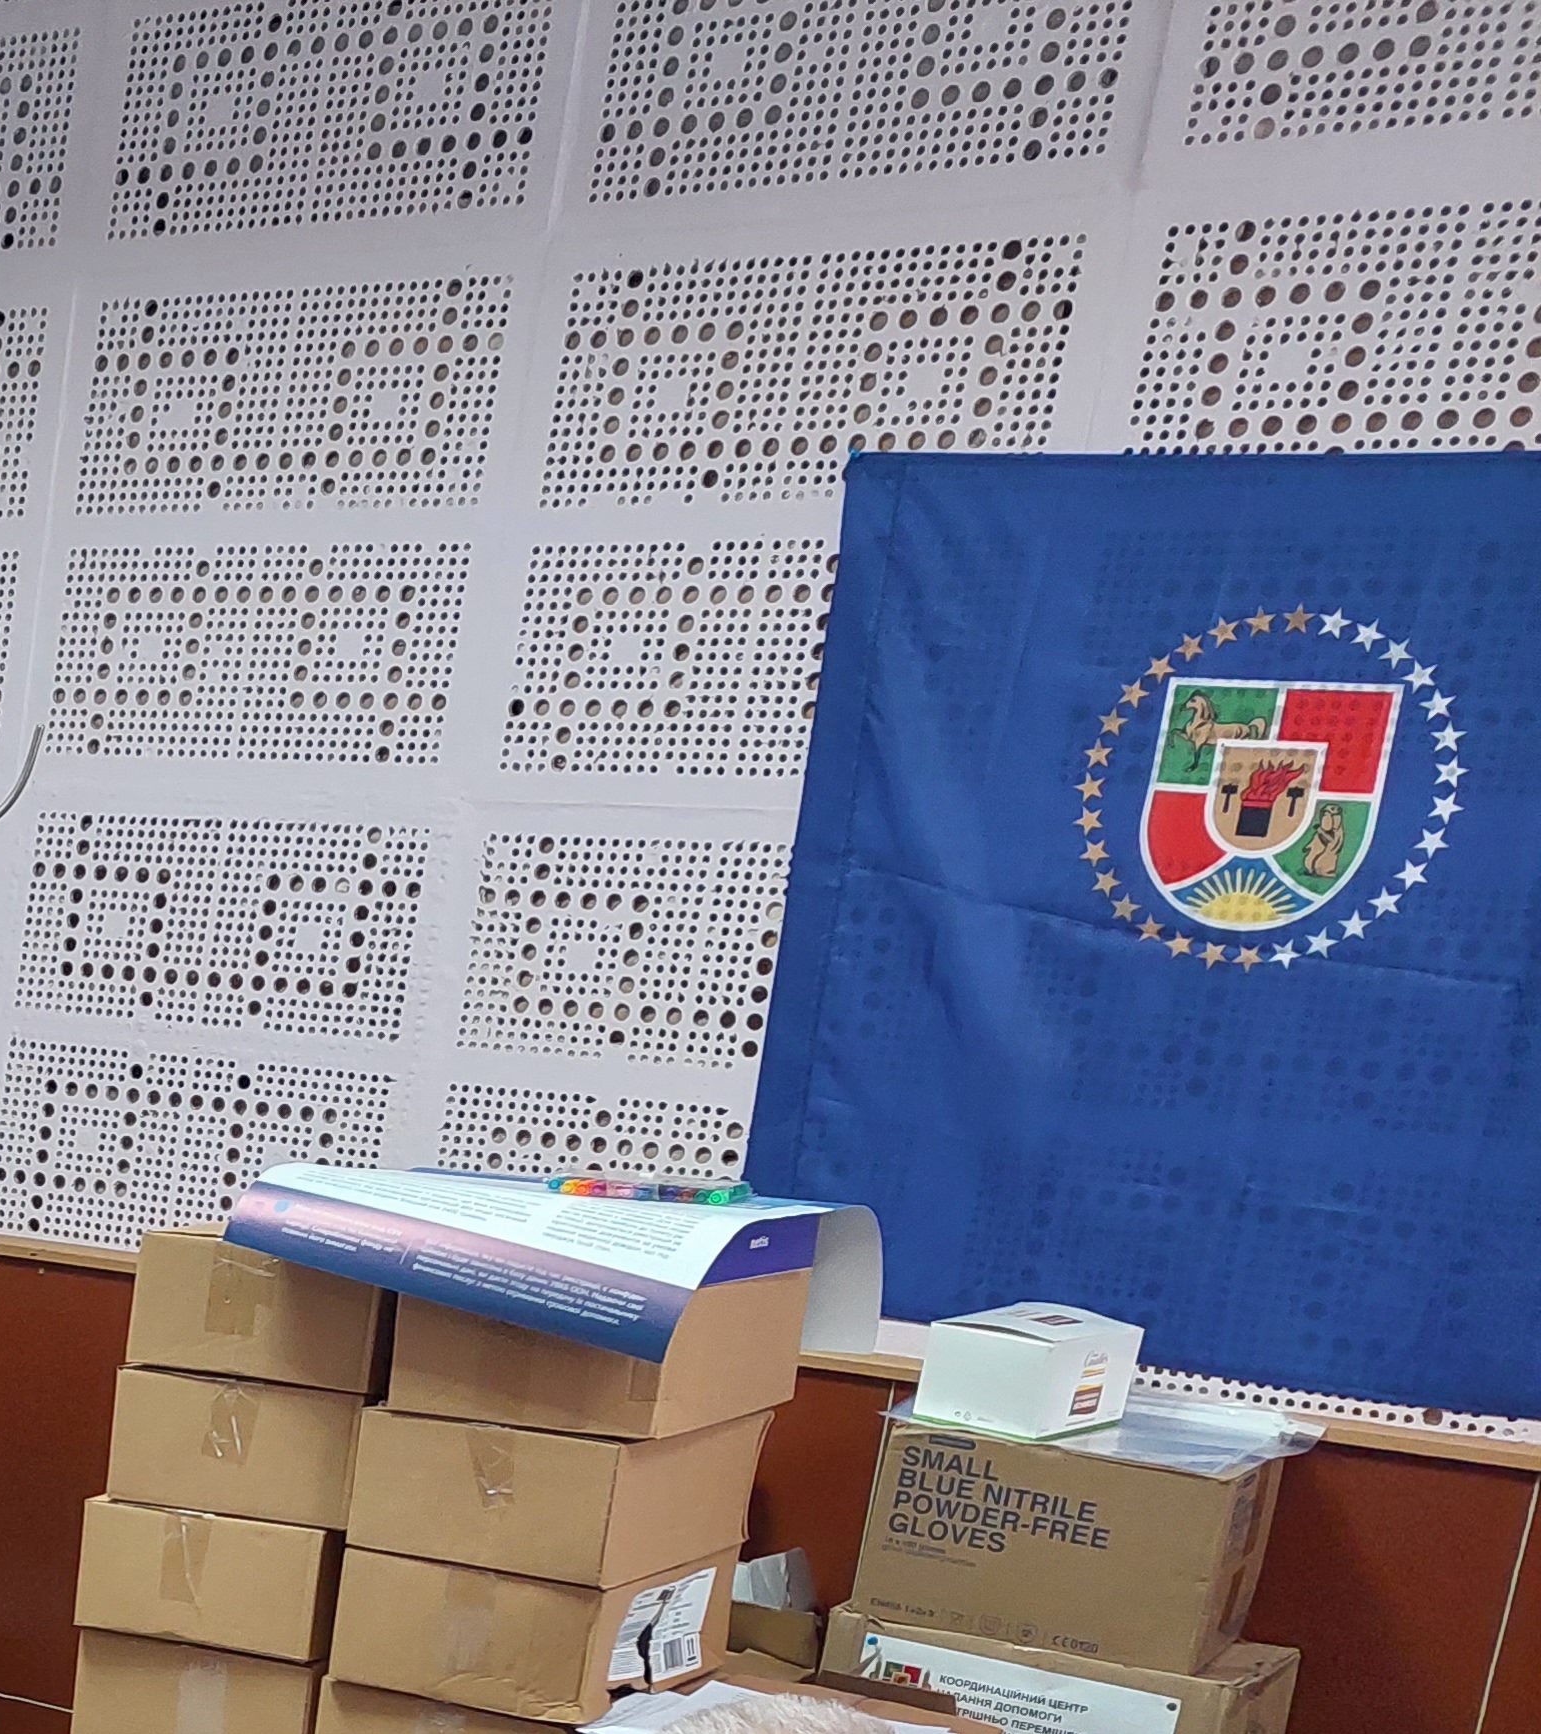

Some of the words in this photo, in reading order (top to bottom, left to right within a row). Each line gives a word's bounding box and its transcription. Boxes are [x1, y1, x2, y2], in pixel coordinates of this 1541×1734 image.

[902, 1445, 999, 1482] SMALL
[897, 1467, 975, 1500] BLUE
[983, 1483, 1098, 1523] NITRILE
[888, 1512, 1006, 1553] GLOVES
[893, 1490, 1111, 1550] POWDER-FREE
[939, 1674, 1046, 1706] КООРДИНАЦІЙНИЙ
[1048, 1699, 1089, 1715] ЦЕНТР
[993, 1702, 1063, 1724] ДОПОМОГИ
